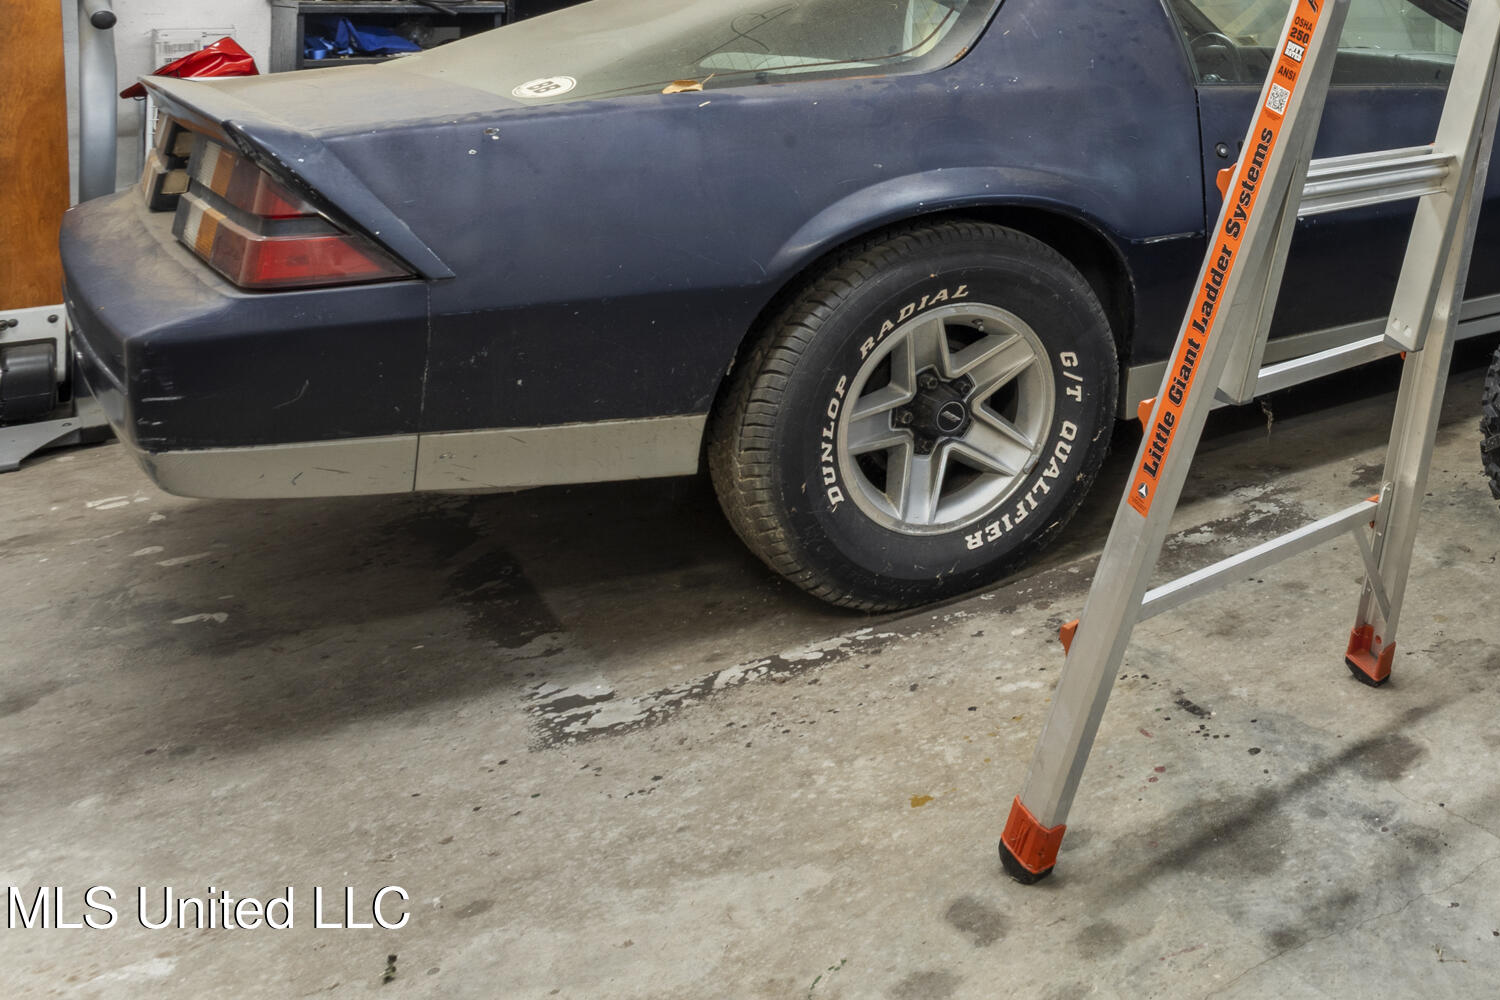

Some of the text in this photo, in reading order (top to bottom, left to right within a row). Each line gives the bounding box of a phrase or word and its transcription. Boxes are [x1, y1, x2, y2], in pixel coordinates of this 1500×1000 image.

[1290, 27, 1310, 44] 250
[1295, 16, 1313, 31] OSHA
[1277, 65, 1297, 81] ANSI
[860, 284, 969, 360] RADIAL
[1143, 410, 1176, 480] Little
[1168, 337, 1200, 408] Giant
[1191, 243, 1233, 337] Ladder
[1224, 127, 1273, 240] Systems
[1059, 351, 1085, 402] G/T
[821, 375, 847, 506] DUNLOP
[965, 420, 1078, 551] QUALIFIER
